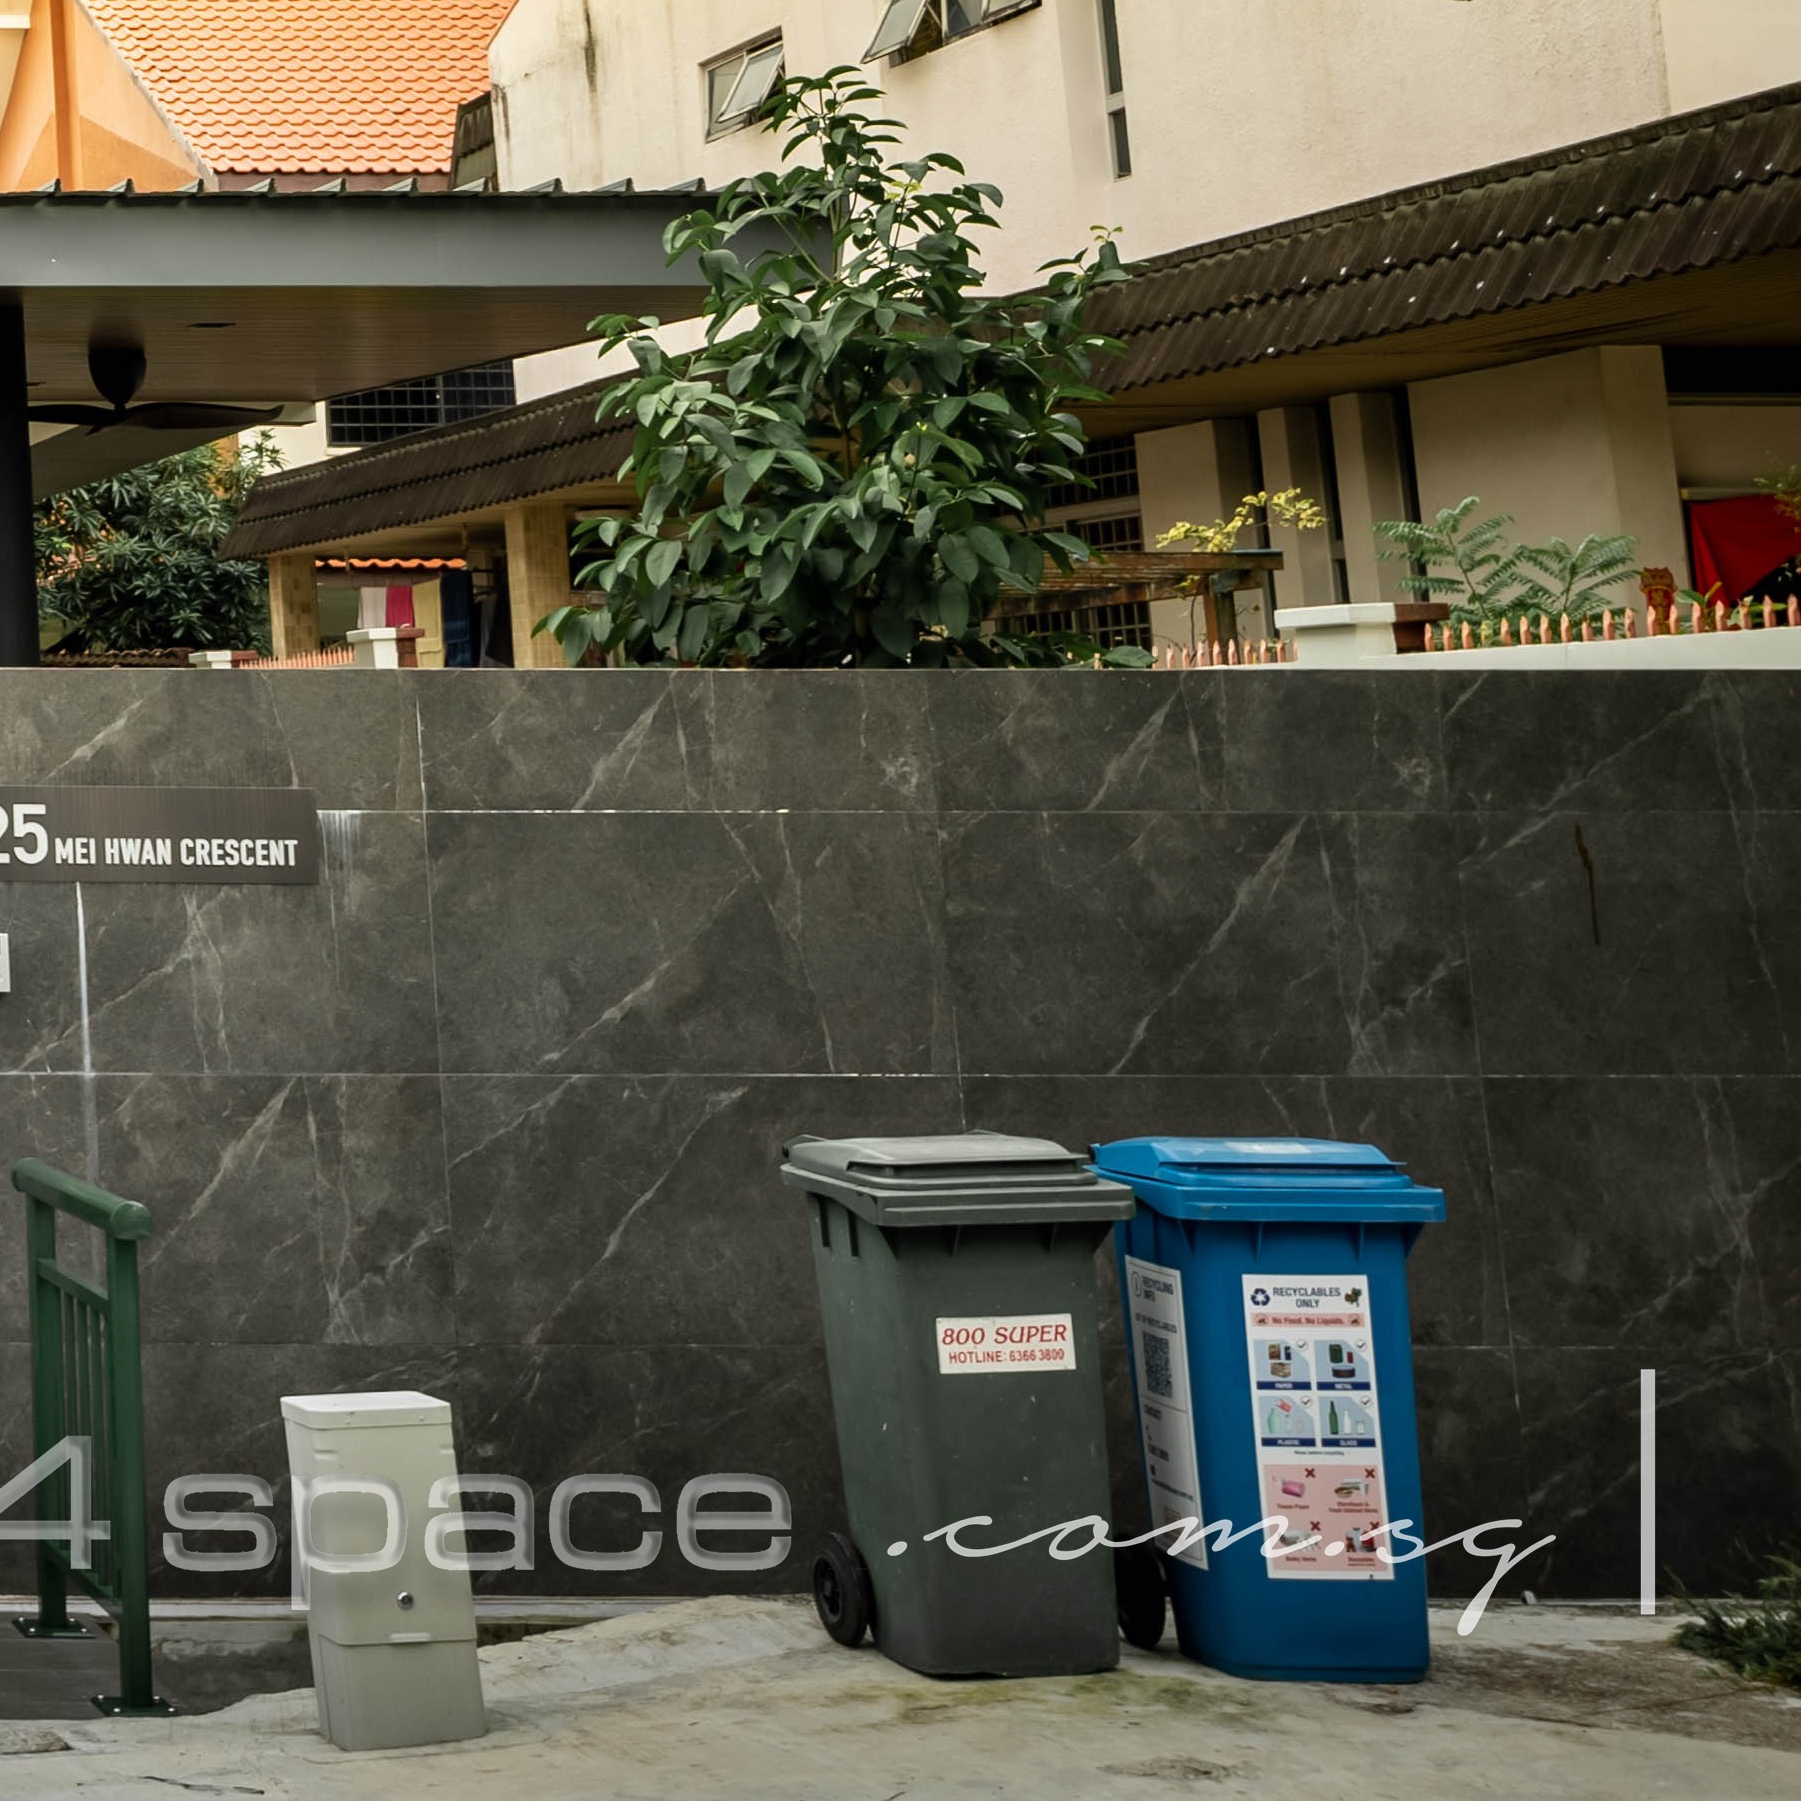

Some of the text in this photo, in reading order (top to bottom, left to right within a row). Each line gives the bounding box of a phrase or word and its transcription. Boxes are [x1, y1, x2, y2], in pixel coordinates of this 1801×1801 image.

[55, 837, 96, 865] MEI
[105, 837, 172, 866] HWAN
[180, 838, 299, 867] CRESCENT
[1272, 1287, 1341, 1297] RECYCLABLES
[1295, 1298, 1320, 1308] ONLY
[942, 1324, 1067, 1346] 800 SUPER
